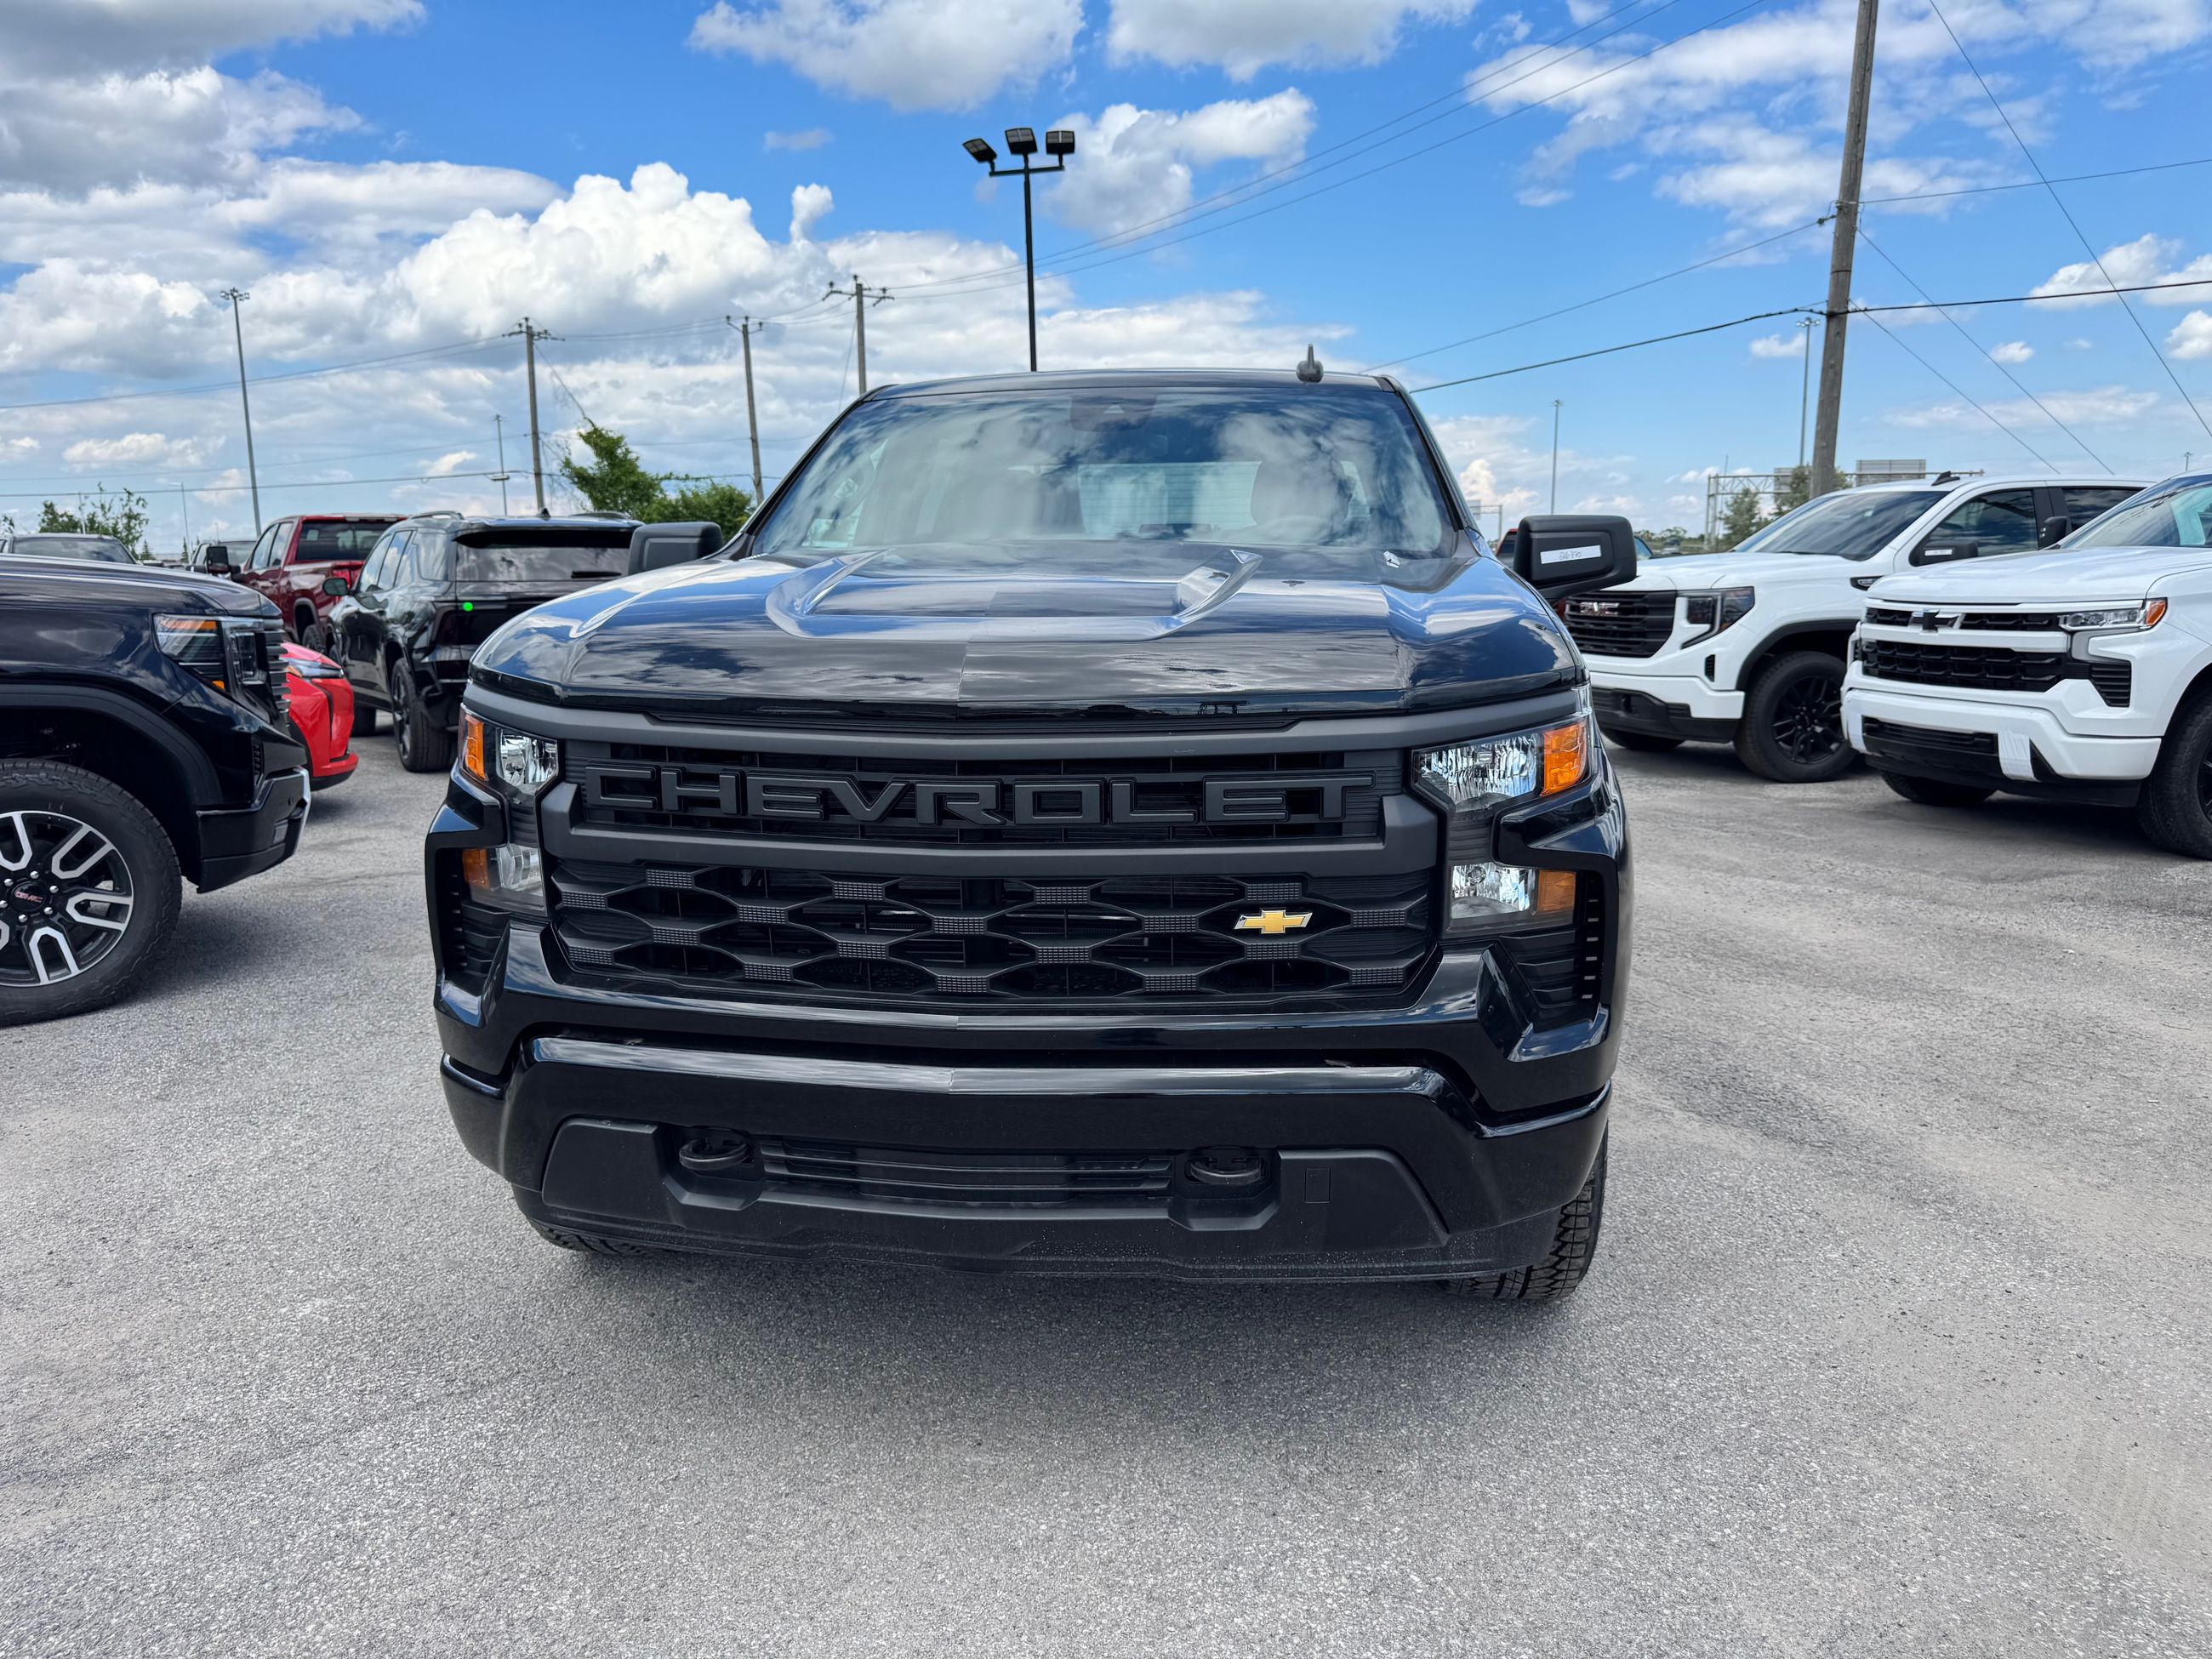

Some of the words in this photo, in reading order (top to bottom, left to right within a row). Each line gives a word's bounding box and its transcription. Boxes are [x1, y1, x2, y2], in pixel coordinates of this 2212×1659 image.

[1579, 601, 1620, 616] GMC
[584, 763, 1377, 826] CHEVROLET
[14, 891, 43, 903] GMC
